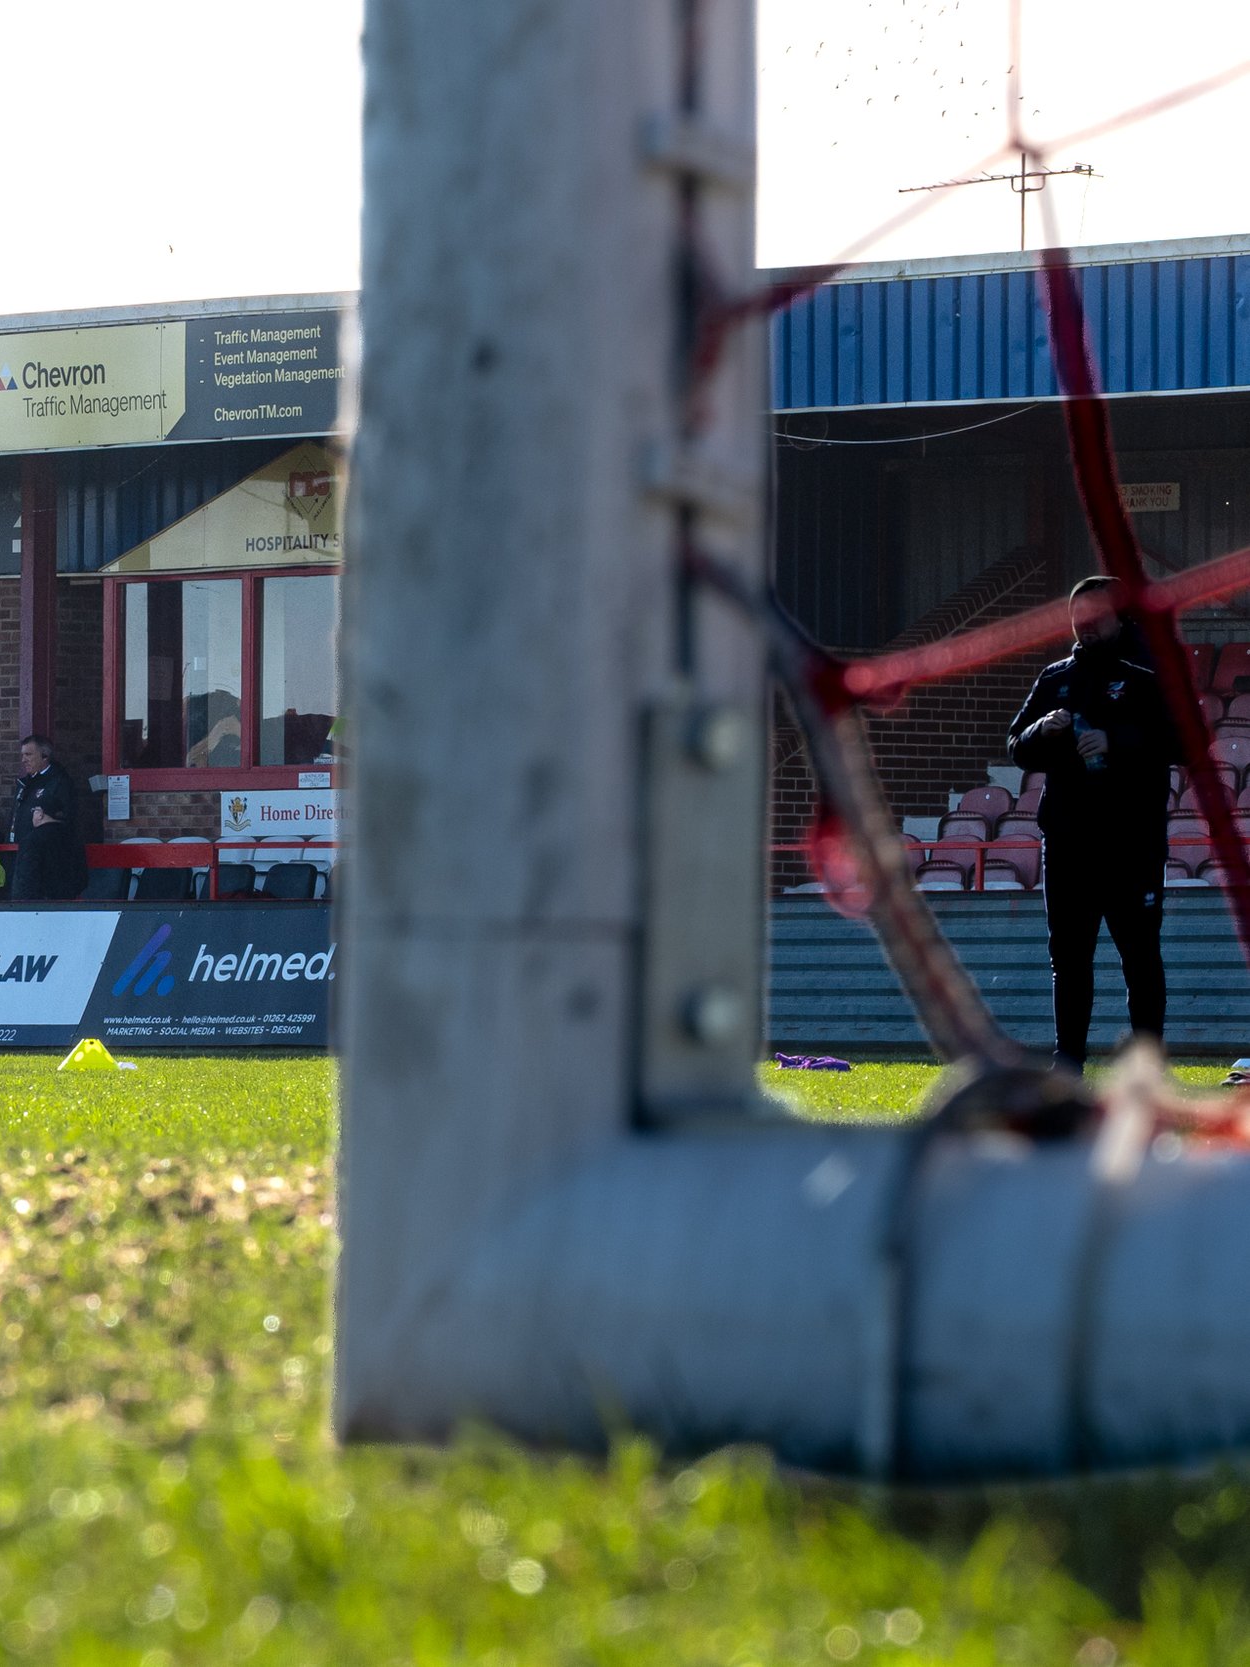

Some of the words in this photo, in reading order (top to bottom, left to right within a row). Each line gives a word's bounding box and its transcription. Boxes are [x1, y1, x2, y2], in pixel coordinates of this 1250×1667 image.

[214, 330, 248, 345] Traffic
[250, 325, 321, 343] Management
[214, 351, 244, 366] Event
[247, 346, 317, 364] Management
[22, 362, 105, 389] Chevron
[214, 370, 272, 388] Vegetation
[274, 365, 346, 383] Management
[22, 395, 66, 418] Traffic
[70, 390, 167, 417] Management
[214, 404, 302, 422] ChevronTM.com
[1130, 485, 1172, 496] SMOKING
[1150, 496, 1169, 507] YOU
[245, 533, 329, 552] HOSPITALITY
[260, 805, 300, 821] Home
[103, 1015, 172, 1024] www.helmed.co.uk
[181, 1014, 256, 1025] hello@helmed.co.uk
[262, 1014, 286, 1023] 01262
[286, 1013, 316, 1023] 425991
[106, 1026, 153, 1036] MARKETING
[159, 1026, 188, 1036] SOCIAL
[189, 1026, 216, 1035] MEDIA
[225, 1025, 265, 1035] WEBSITES
[271, 1025, 303, 1034] DESIGN
